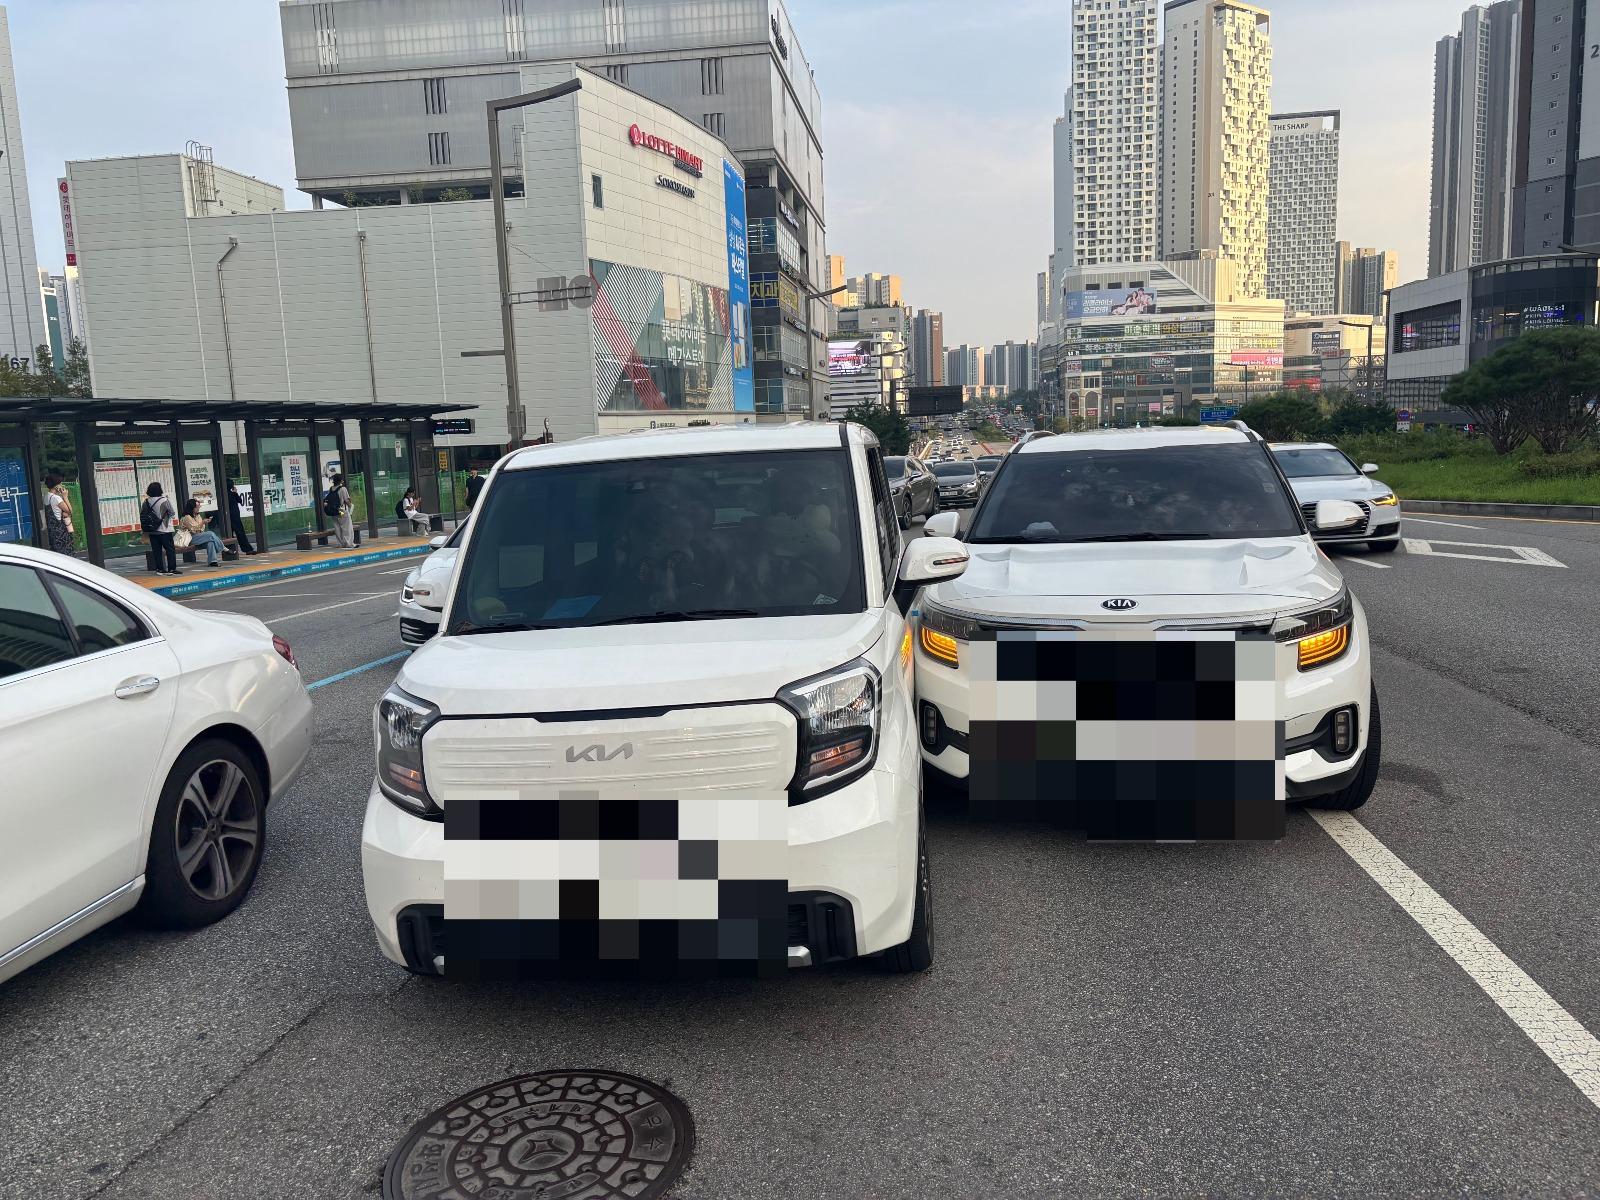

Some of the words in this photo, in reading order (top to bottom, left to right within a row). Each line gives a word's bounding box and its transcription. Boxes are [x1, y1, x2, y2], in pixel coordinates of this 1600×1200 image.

[1287, 122, 1309, 130] SHARP
[639, 131, 675, 157] LOTTE
[675, 145, 704, 171] HIMART
[750, 281, 779, 299] 치과
[661, 319, 707, 344] 롯데하이마트
[10, 356, 30, 370] 67
[667, 345, 705, 369] 메가스토어
[1107, 599, 1132, 608] KIA
[565, 741, 634, 763] KIA
